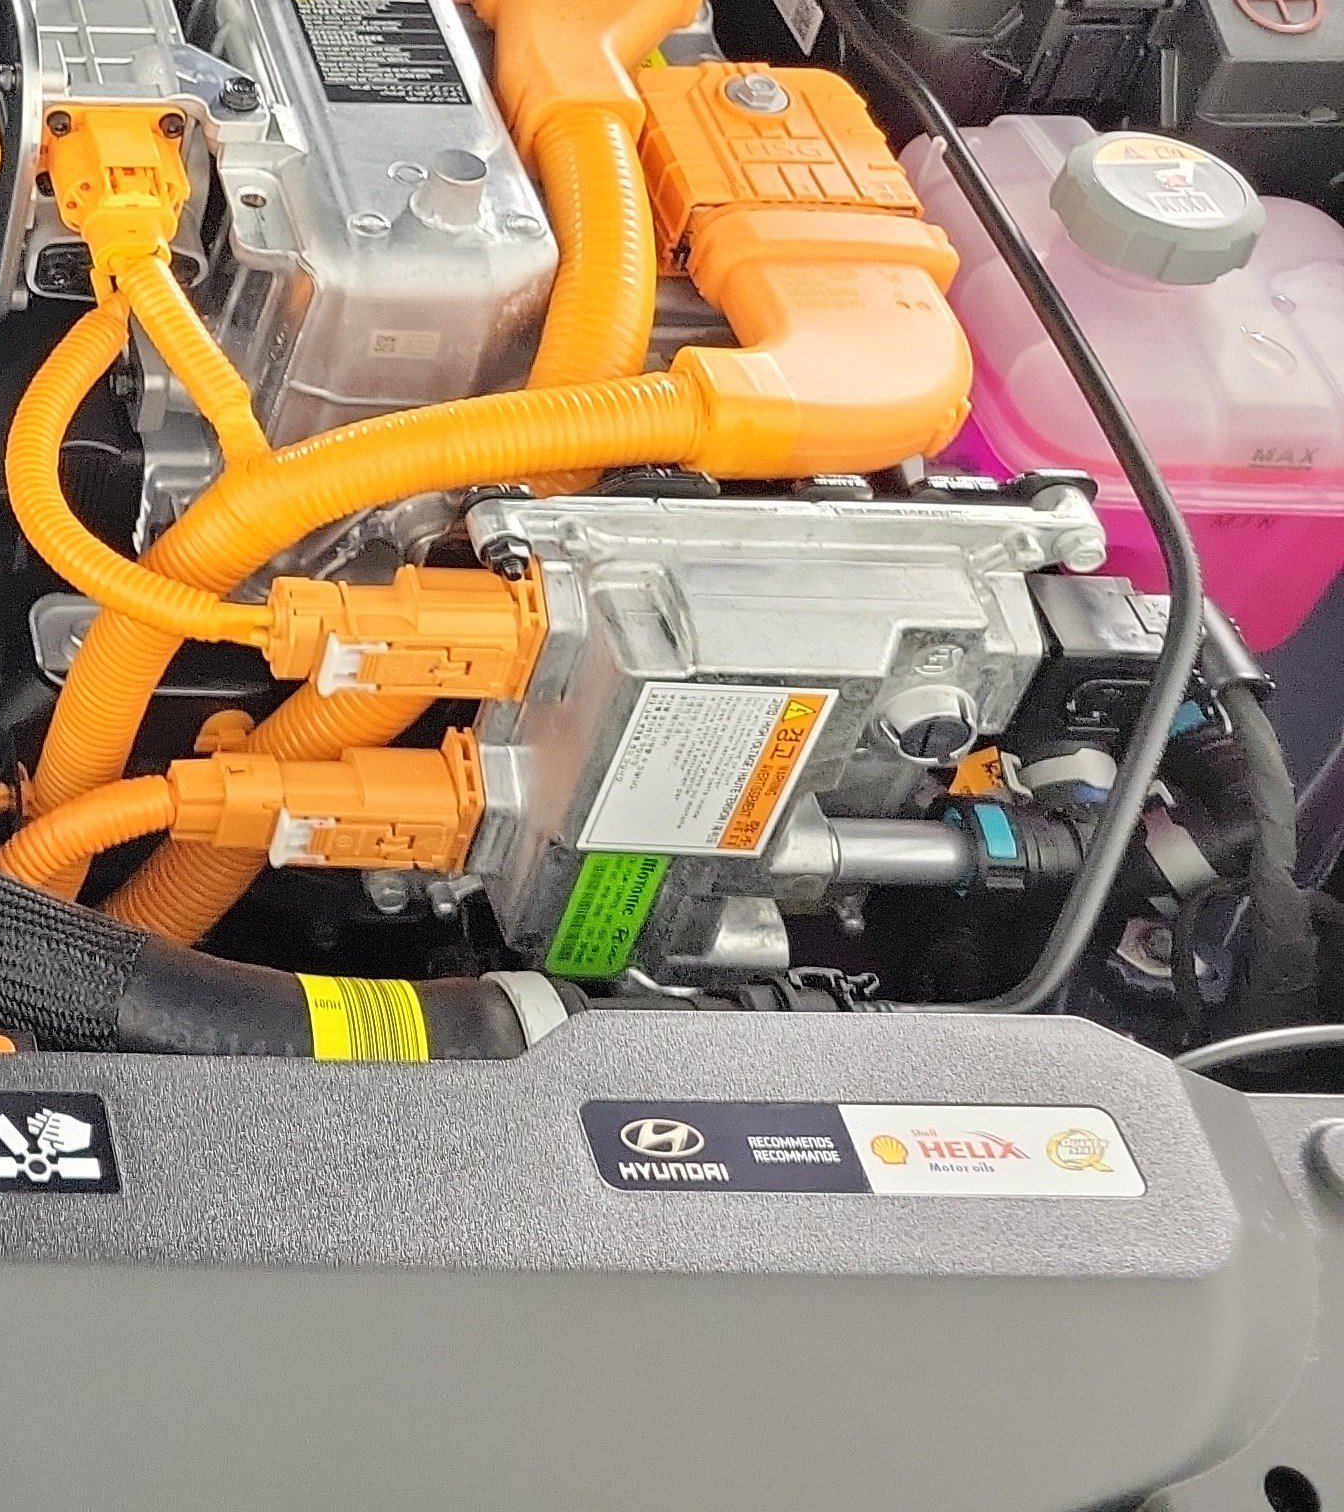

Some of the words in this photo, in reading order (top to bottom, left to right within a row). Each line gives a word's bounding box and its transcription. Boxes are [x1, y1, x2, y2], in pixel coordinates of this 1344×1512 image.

[1252, 448, 1318, 464] MAX
[766, 727, 806, 760] 경고
[910, 1128, 937, 1138] Shell
[747, 1136, 836, 1150] RECOMMENDS
[916, 1140, 1025, 1160] HELIX
[752, 1150, 842, 1165] RECOMMANDE
[618, 1161, 730, 1182] HYUNDAI
[929, 1161, 968, 1173] Motor
[973, 1162, 995, 1174] oils
